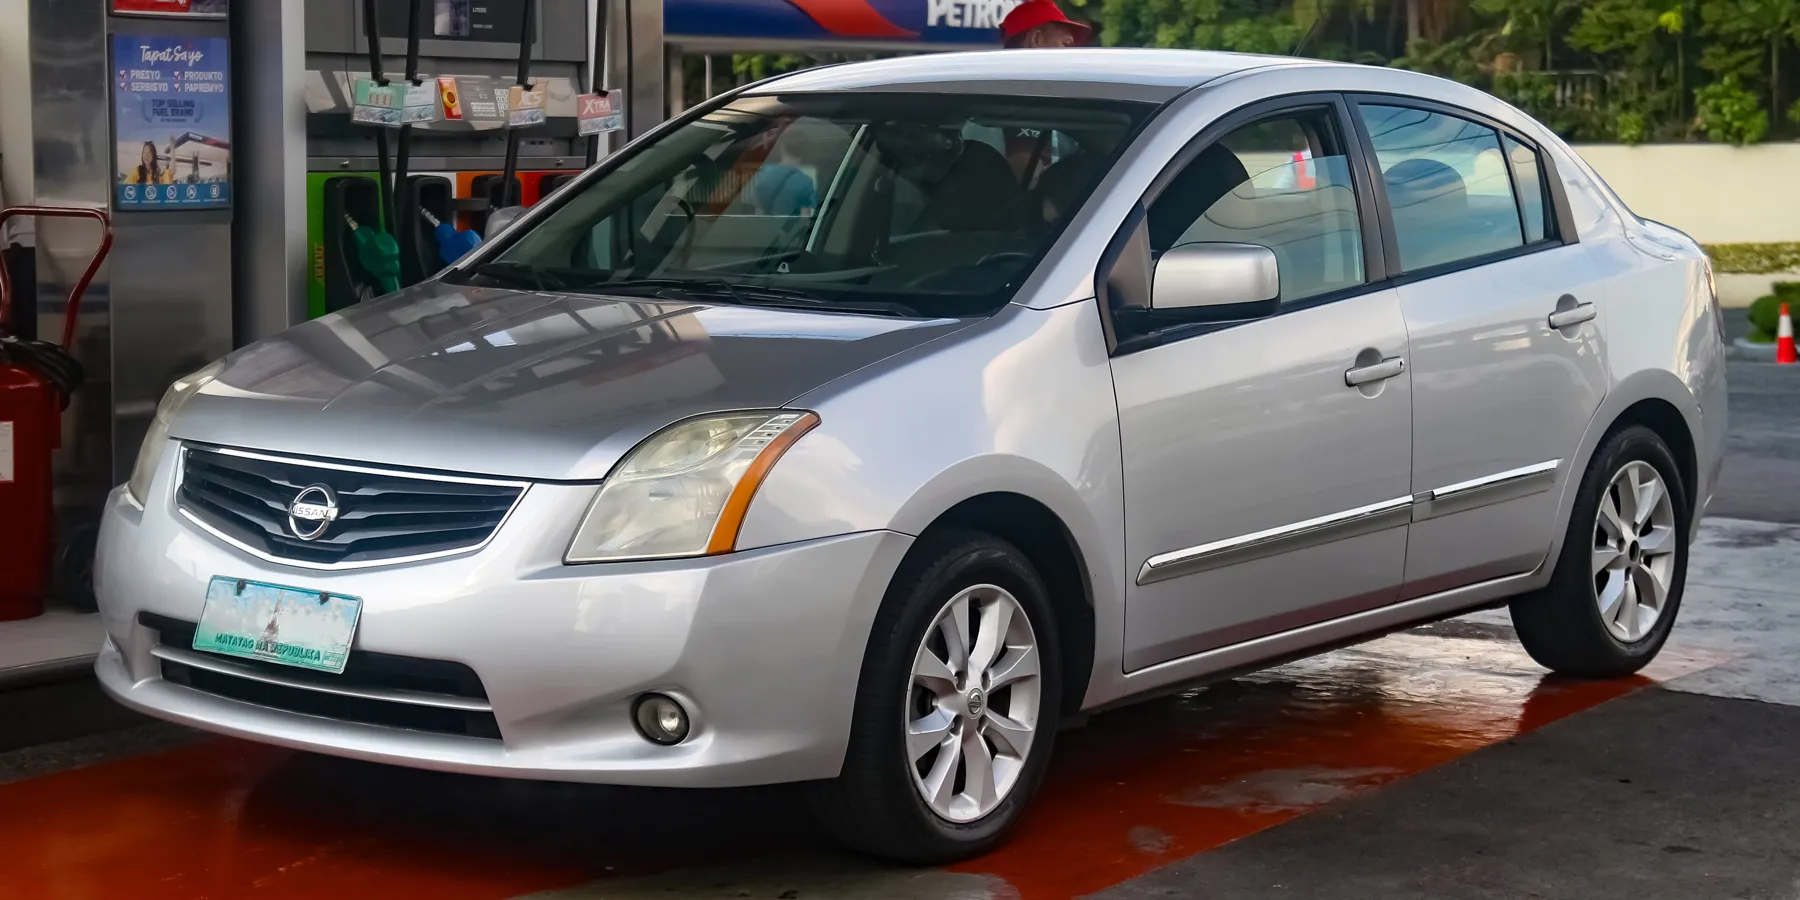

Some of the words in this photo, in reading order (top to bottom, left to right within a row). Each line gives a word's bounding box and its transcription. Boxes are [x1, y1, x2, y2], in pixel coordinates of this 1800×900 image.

[140, 45, 173, 66] Tapat
[130, 69, 160, 80] PRESYO
[184, 71, 223, 81] PRODUKTO
[130, 82, 169, 92] SERBISYO
[184, 83, 224, 93] PAPREMYO
[152, 99, 165, 107] TOP
[167, 99, 195, 108] SELLING
[582, 98, 611, 115] XTRA
[152, 108, 169, 116] FUEL
[170, 108, 194, 117] BRAND
[288, 503, 329, 518] NISSAN
[214, 633, 254, 649] MATATAG
[270, 641, 321, 661] REPUBLIKA
